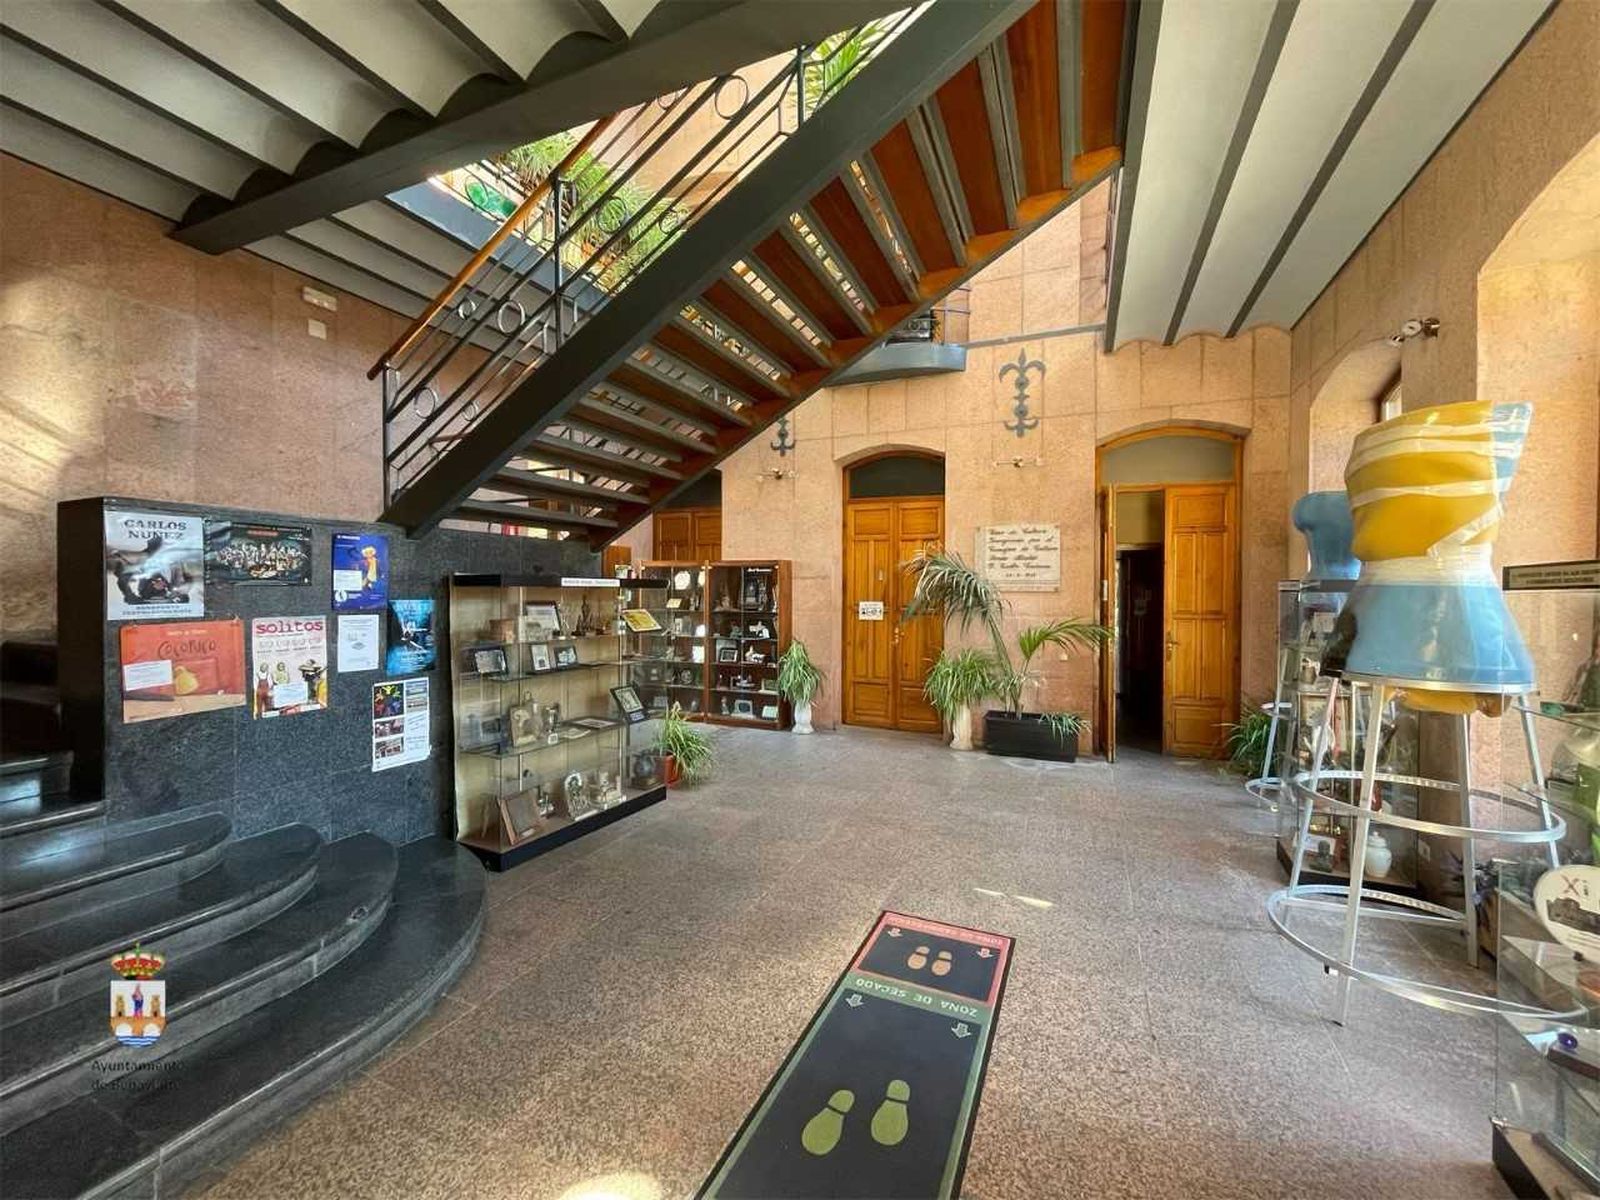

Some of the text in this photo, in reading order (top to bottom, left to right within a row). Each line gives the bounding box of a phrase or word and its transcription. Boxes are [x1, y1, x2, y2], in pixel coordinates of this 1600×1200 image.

[124, 519, 187, 531] CARLOS
[256, 620, 324, 635] solitos
[856, 978, 978, 1018] ZONA DE SECADO
